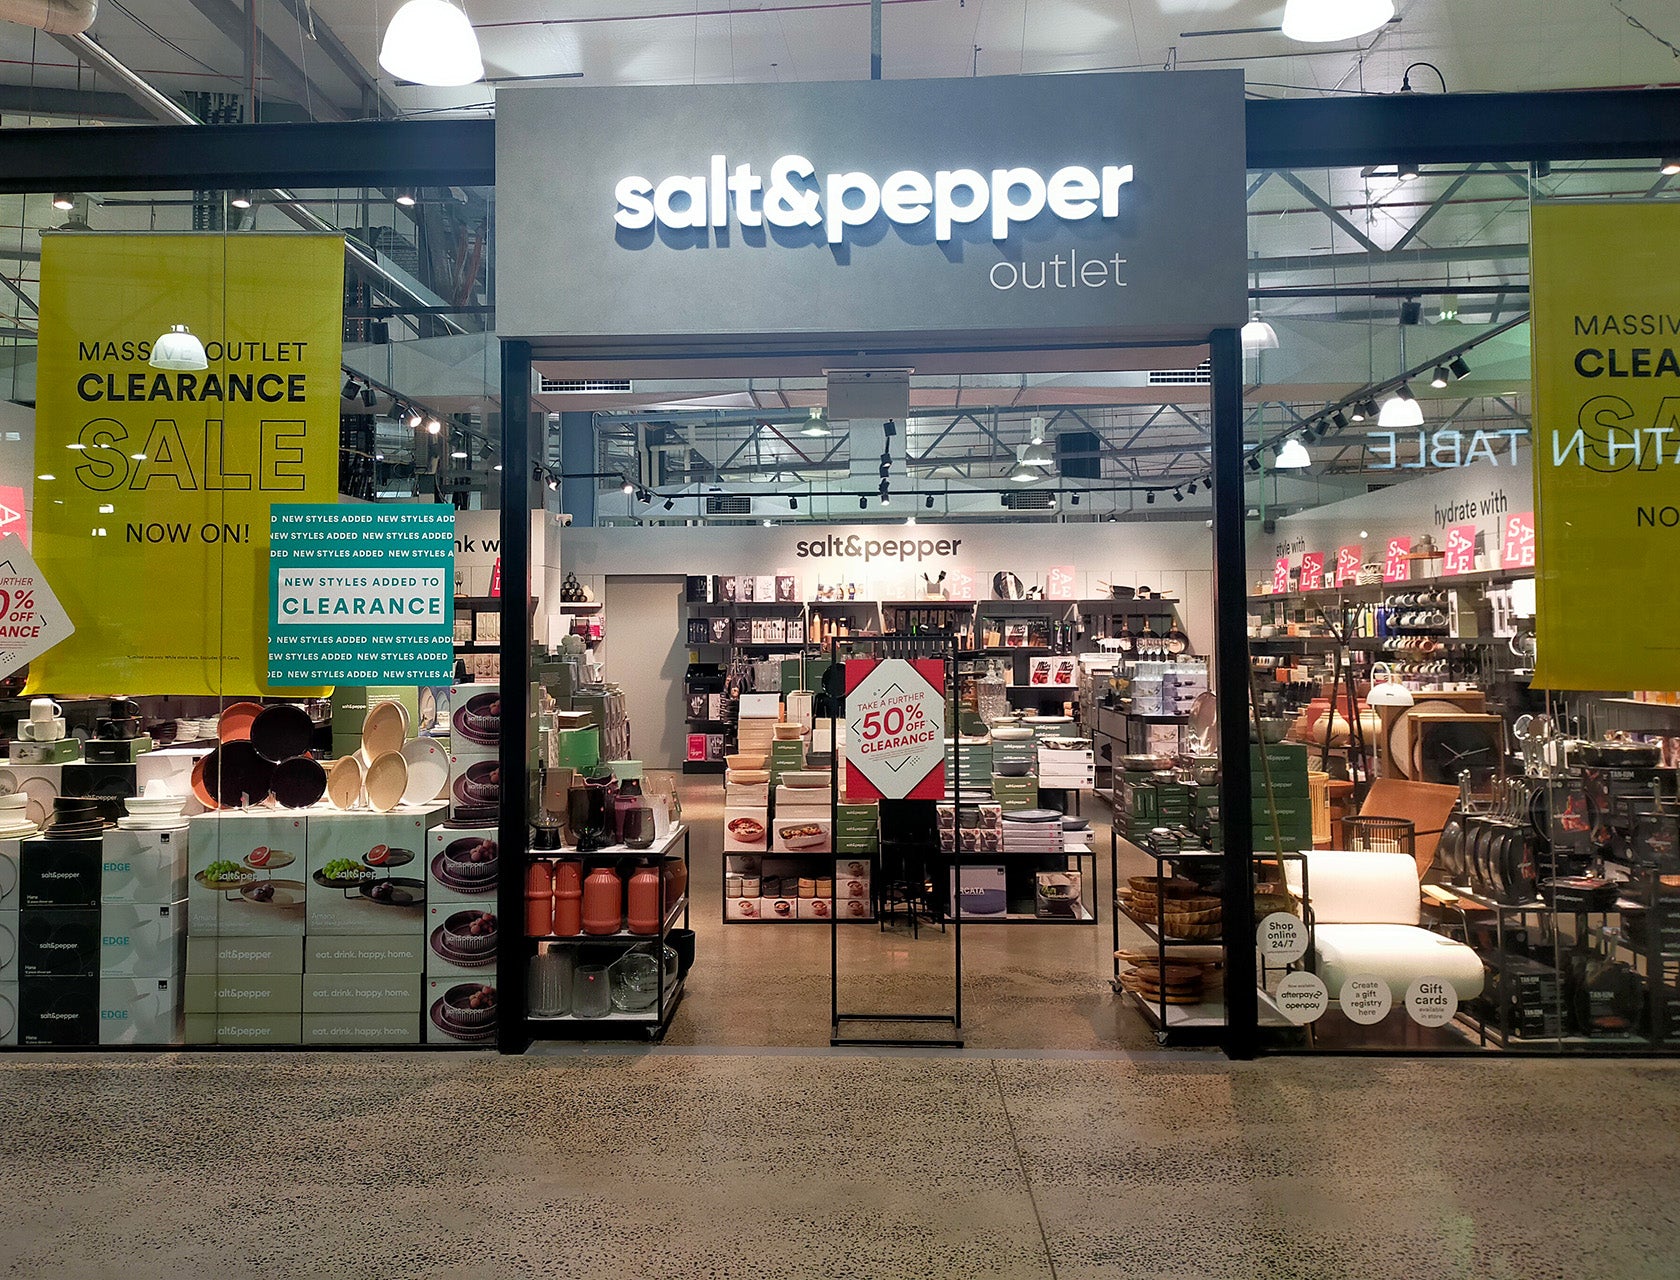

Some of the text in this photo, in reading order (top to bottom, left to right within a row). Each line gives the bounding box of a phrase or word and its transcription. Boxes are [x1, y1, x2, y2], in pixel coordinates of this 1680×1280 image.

[613, 153, 1135, 243] salt&pepper
[989, 249, 1128, 291] outlet
[206, 341, 308, 362] OUTLET
[76, 373, 306, 403] CLEARANCE
[75, 417, 306, 492] SALE
[1434, 489, 1508, 530] hydrate with
[282, 515, 303, 523] NEW
[305, 515, 339, 523] STYLES
[341, 515, 372, 523] ADDED
[377, 515, 398, 523] NEW
[400, 515, 434, 523] STYLES
[125, 523, 250, 544] NOW ON!
[290, 532, 324, 540] STYLES
[326, 532, 358, 540] ADDED
[362, 532, 383, 540] NEW
[386, 532, 419, 540] STYLES
[422, 532, 453, 540] ADDED
[796, 534, 962, 562] salt&pepper
[1275, 536, 1306, 558] style with
[293, 550, 314, 558] NEW
[316, 550, 350, 558] STYLES
[352, 550, 384, 558] ADDED
[388, 550, 409, 558] NEW
[412, 550, 445, 558] STYLES
[284, 577, 439, 587] NEW STYLES ADDED TO
[282, 597, 441, 615] CLEARANCE
[9, 611, 35, 622] OFF
[276, 636, 298, 644] NEW
[300, 636, 333, 644] STYLES
[336, 636, 367, 644] ADDED
[372, 636, 393, 644] NEW
[395, 636, 429, 644] STYLES
[285, 653, 319, 661] STYLES
[321, 653, 352, 661] ADDED
[357, 653, 378, 661] NEW
[380, 653, 414, 661] STYLES
[416, 653, 448, 661] ADDED
[287, 670, 308, 678] NEW
[311, 670, 344, 678] STYLES
[347, 670, 378, 678] ADDED
[383, 670, 404, 678] NEW
[407, 670, 440, 678] STYLES
[858, 691, 925, 712] TAKE A FURTHER
[862, 702, 924, 740] 50%
[905, 720, 926, 732] OFF
[861, 730, 935, 754] CLEARANCE
[103, 863, 131, 872] EDGE
[41, 871, 80, 879] salt&pepper
[1269, 921, 1294, 932] Shop
[102, 936, 130, 945] EDGE
[1267, 931, 1297, 940] online
[39, 942, 78, 950] salt&pepper
[1272, 940, 1294, 949] 24/7
[214, 950, 272, 961] alt&pepper
[1352, 981, 1379, 989] Create
[1419, 983, 1443, 994] Gift
[214, 989, 272, 1000] alt&pepper
[1281, 990, 1314, 1000] afterpay
[1362, 990, 1376, 999] gift
[1351, 1000, 1382, 1010] registry
[1415, 994, 1448, 1006] cards
[1285, 1002, 1320, 1011] openpay
[40, 1012, 79, 1020] salt&pepper
[101, 1010, 128, 1019] EDGE
[1358, 1008, 1376, 1016] here
[214, 1026, 272, 1037] alt&pepper
